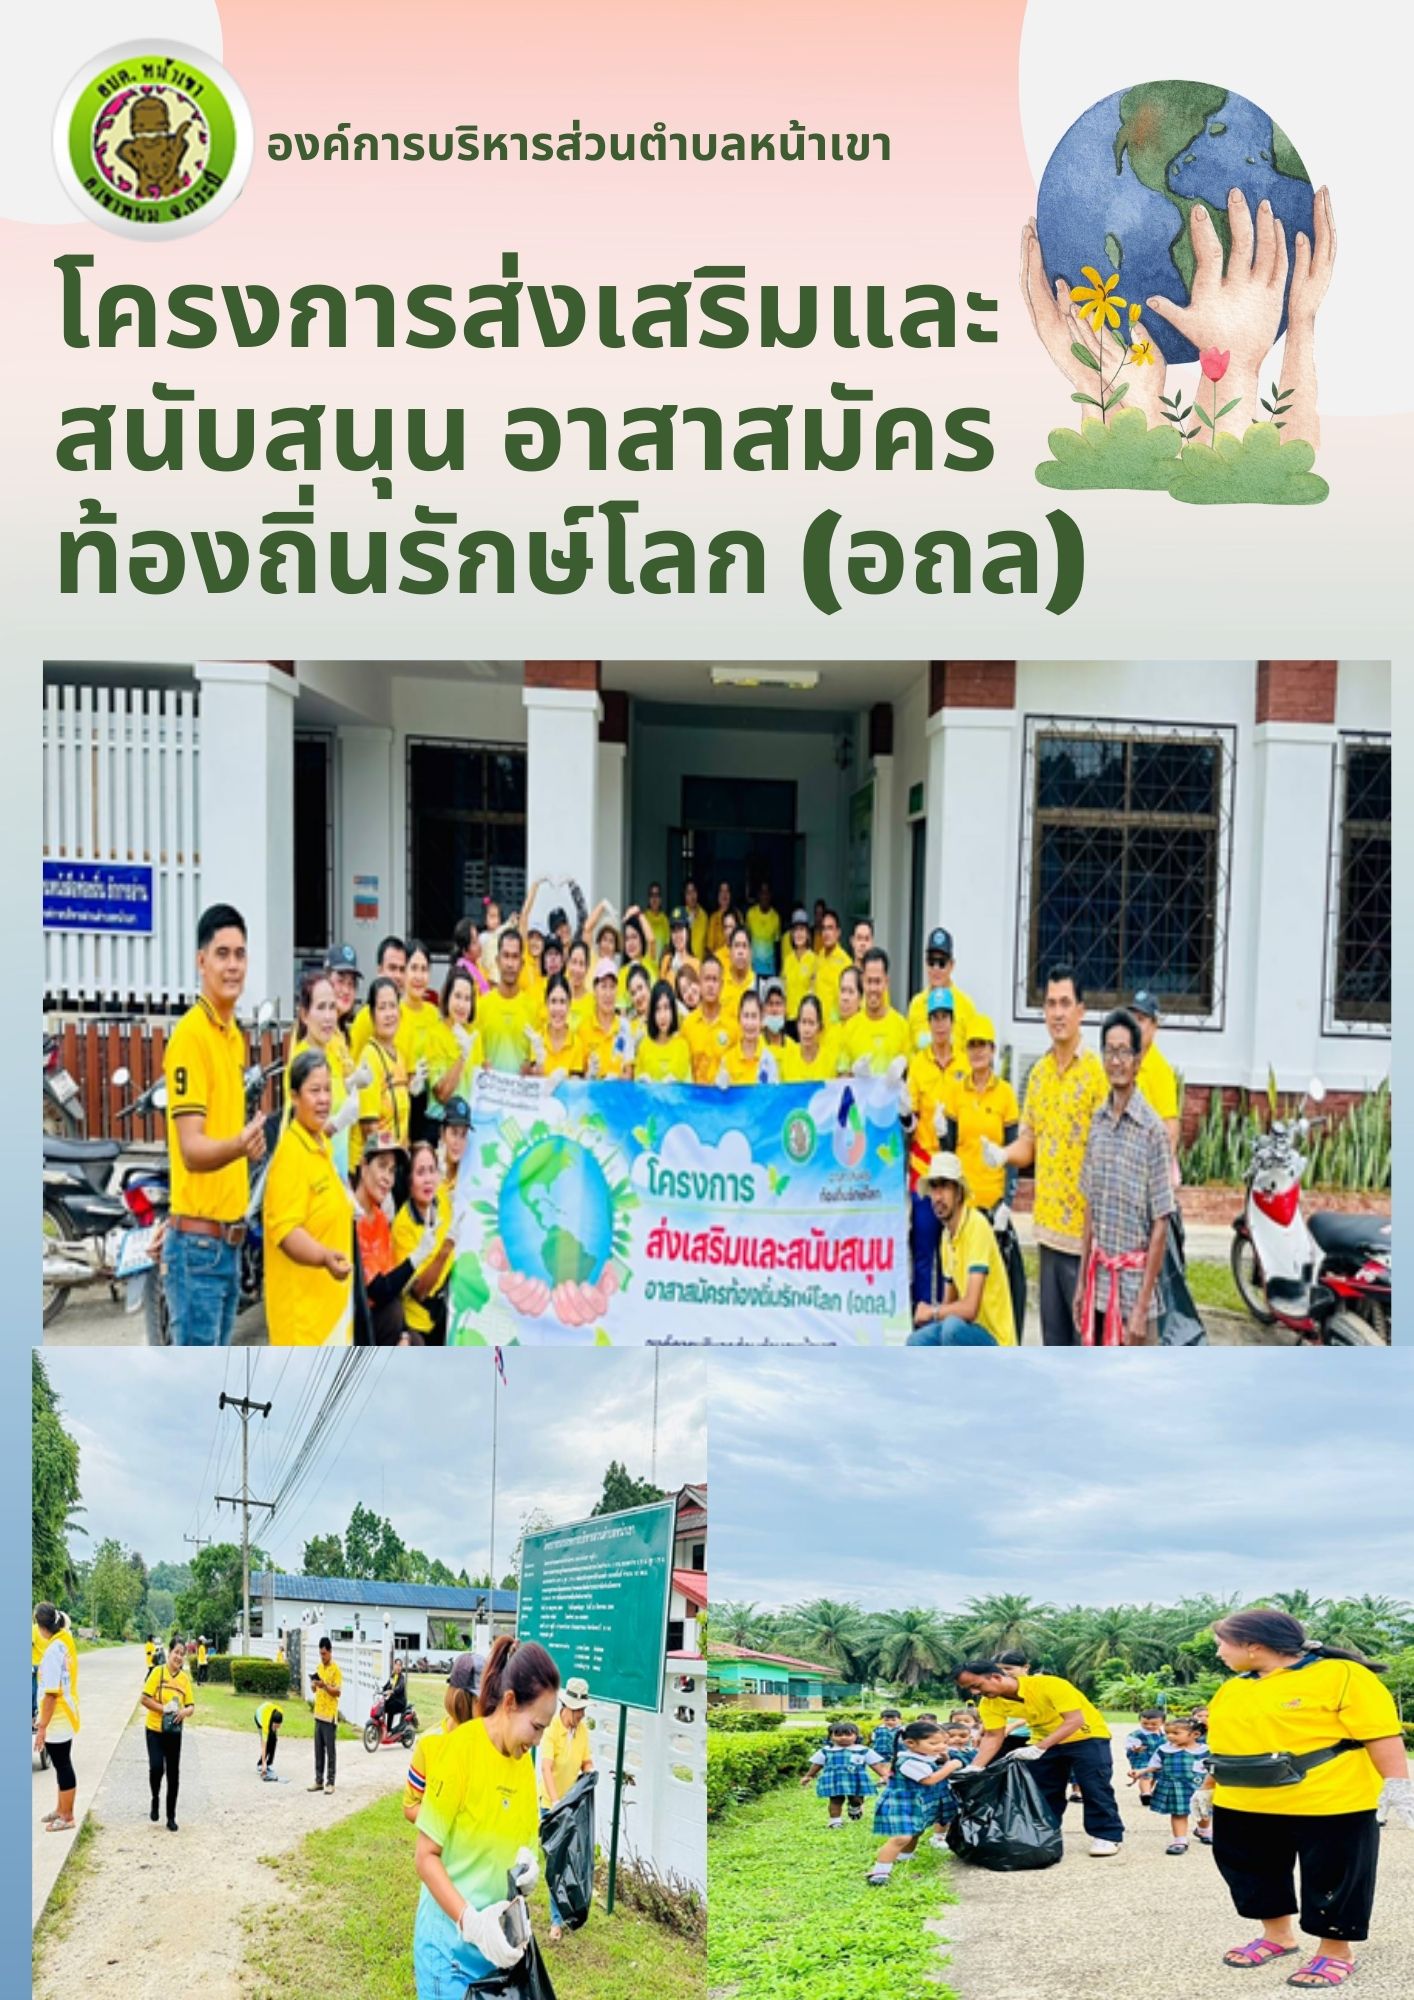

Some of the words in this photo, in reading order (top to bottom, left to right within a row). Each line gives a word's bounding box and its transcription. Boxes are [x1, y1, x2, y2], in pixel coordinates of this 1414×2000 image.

[174, 1066, 188, 1096] 9
[647, 1155, 756, 1204] โครงการ
[645, 1217, 894, 1286] ส่งเสริมและสนับสนุน
